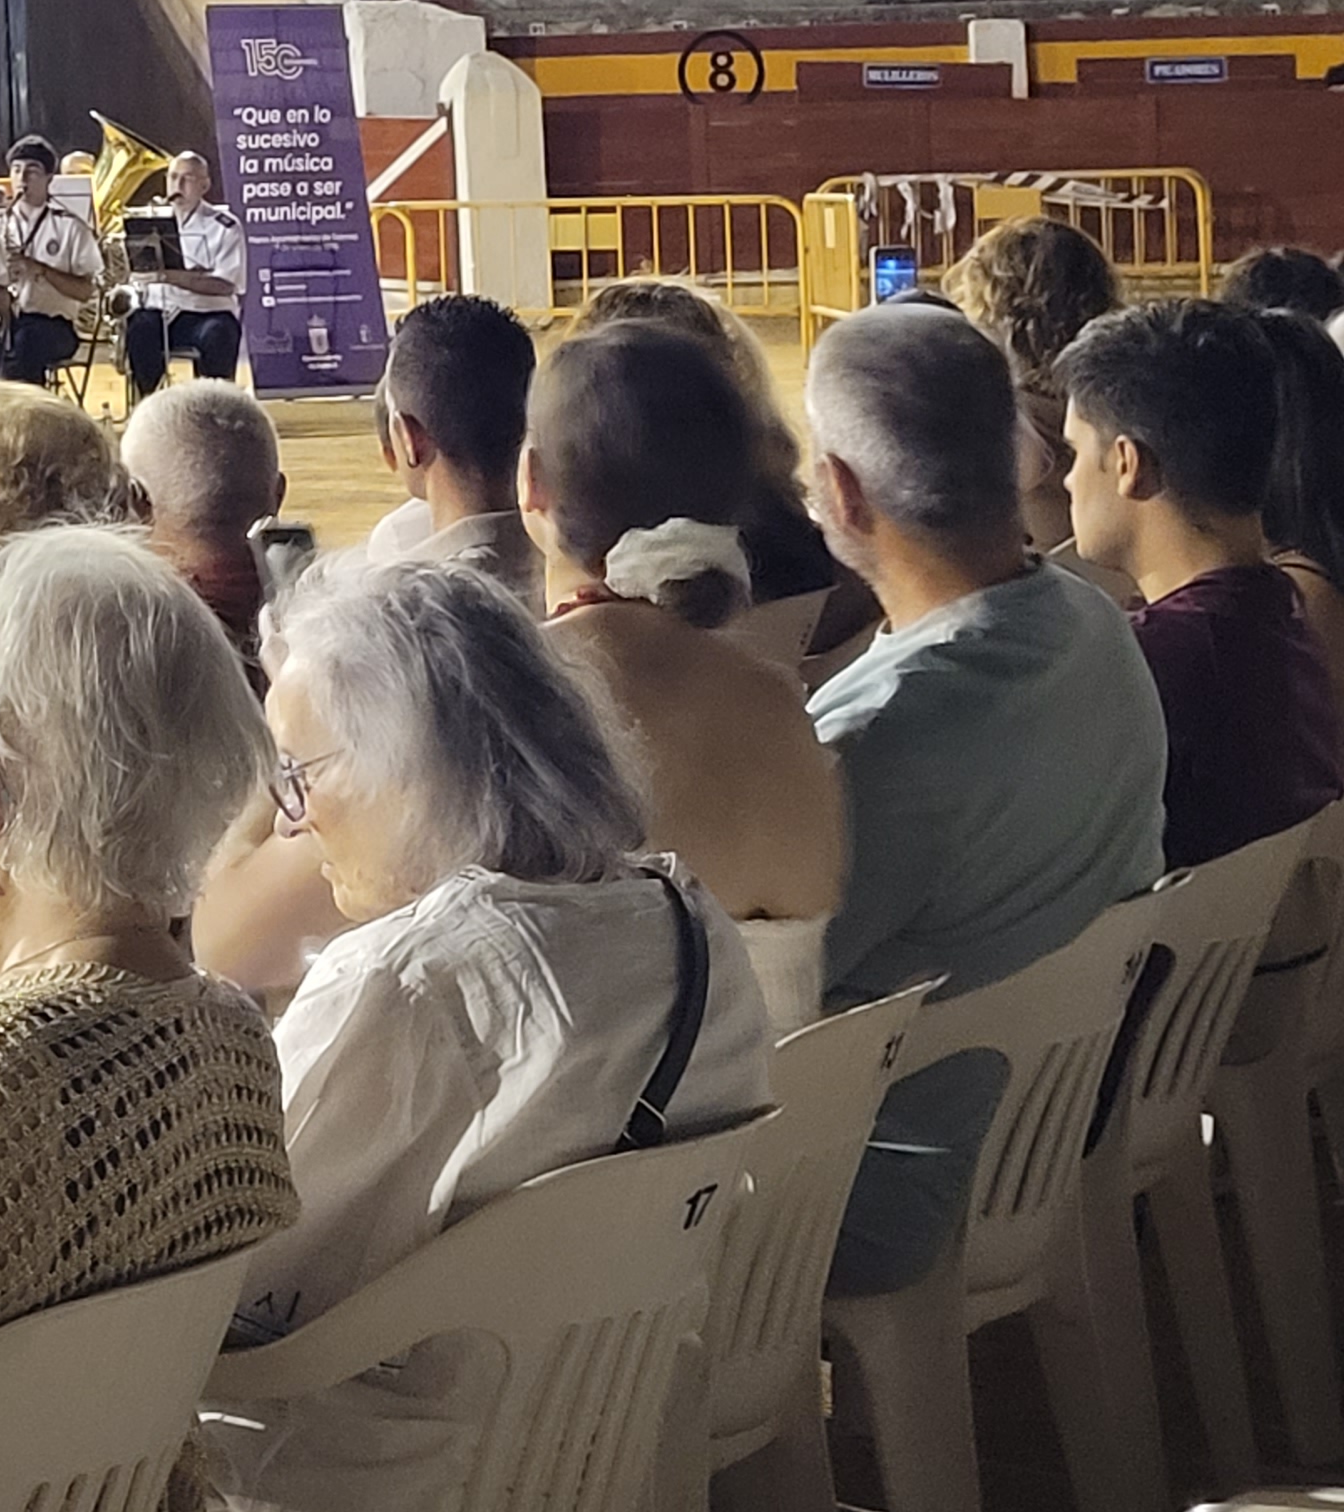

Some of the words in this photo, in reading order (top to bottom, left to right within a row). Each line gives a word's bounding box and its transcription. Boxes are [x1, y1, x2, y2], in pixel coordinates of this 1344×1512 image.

[708, 51, 737, 92] 8
[286, 109, 310, 124] en
[314, 104, 331, 123] lo
[236, 129, 320, 150] sucesivo
[240, 156, 258, 174] la
[264, 153, 333, 173] música
[296, 181, 309, 196] a
[313, 180, 343, 196] ser
[683, 1183, 718, 1230] 17
